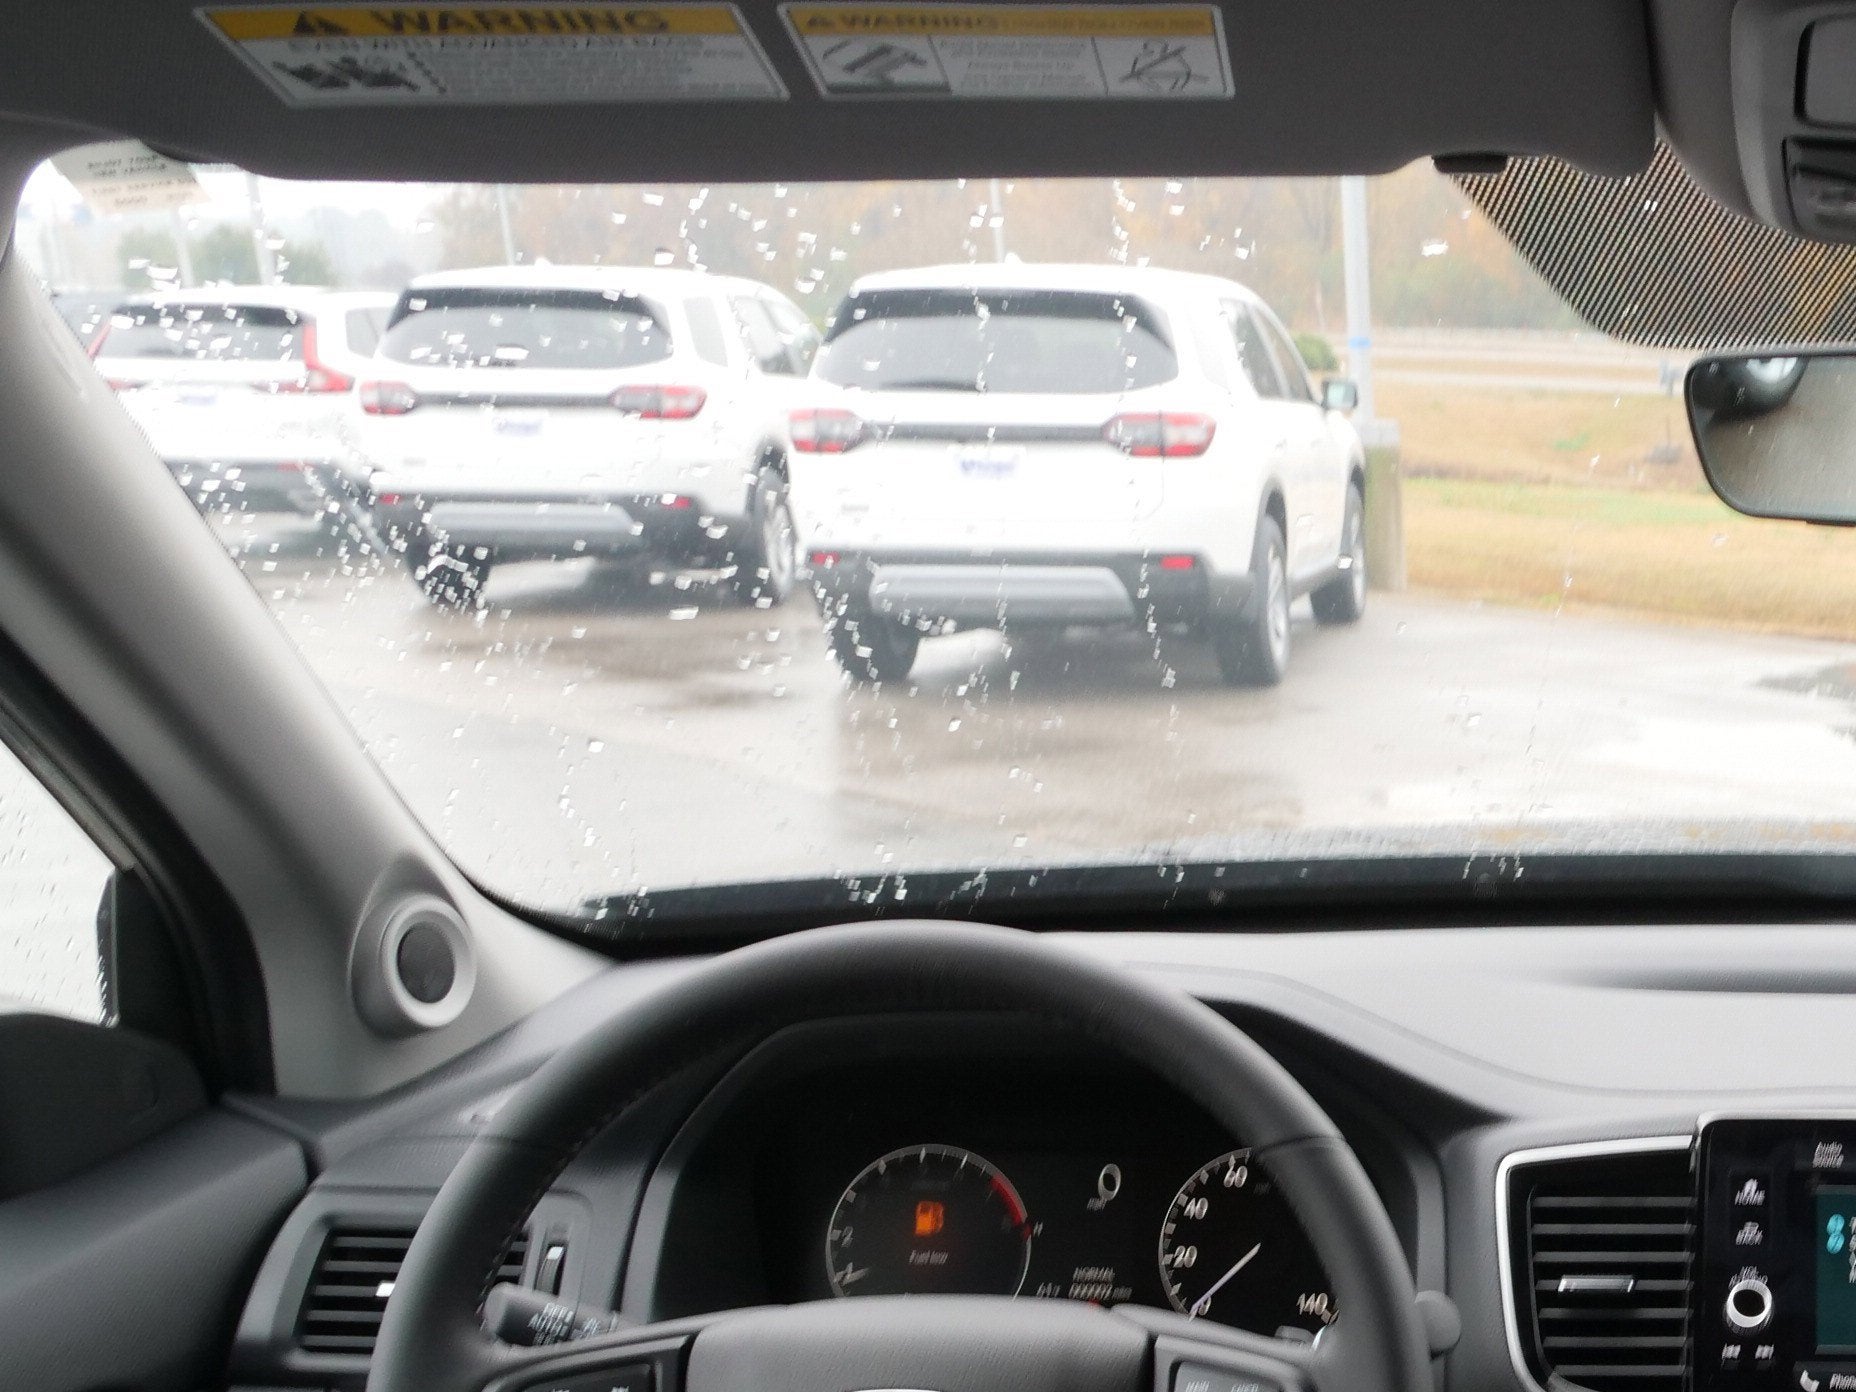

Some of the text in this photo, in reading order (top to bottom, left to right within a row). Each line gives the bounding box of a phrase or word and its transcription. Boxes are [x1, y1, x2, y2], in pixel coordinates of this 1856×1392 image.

[371, 8, 669, 35] WARNING
[1223, 1165, 1248, 1188] 60
[1184, 1197, 1208, 1220] 40
[1174, 1245, 1198, 1268] 20
[1296, 1293, 1328, 1315] 140
